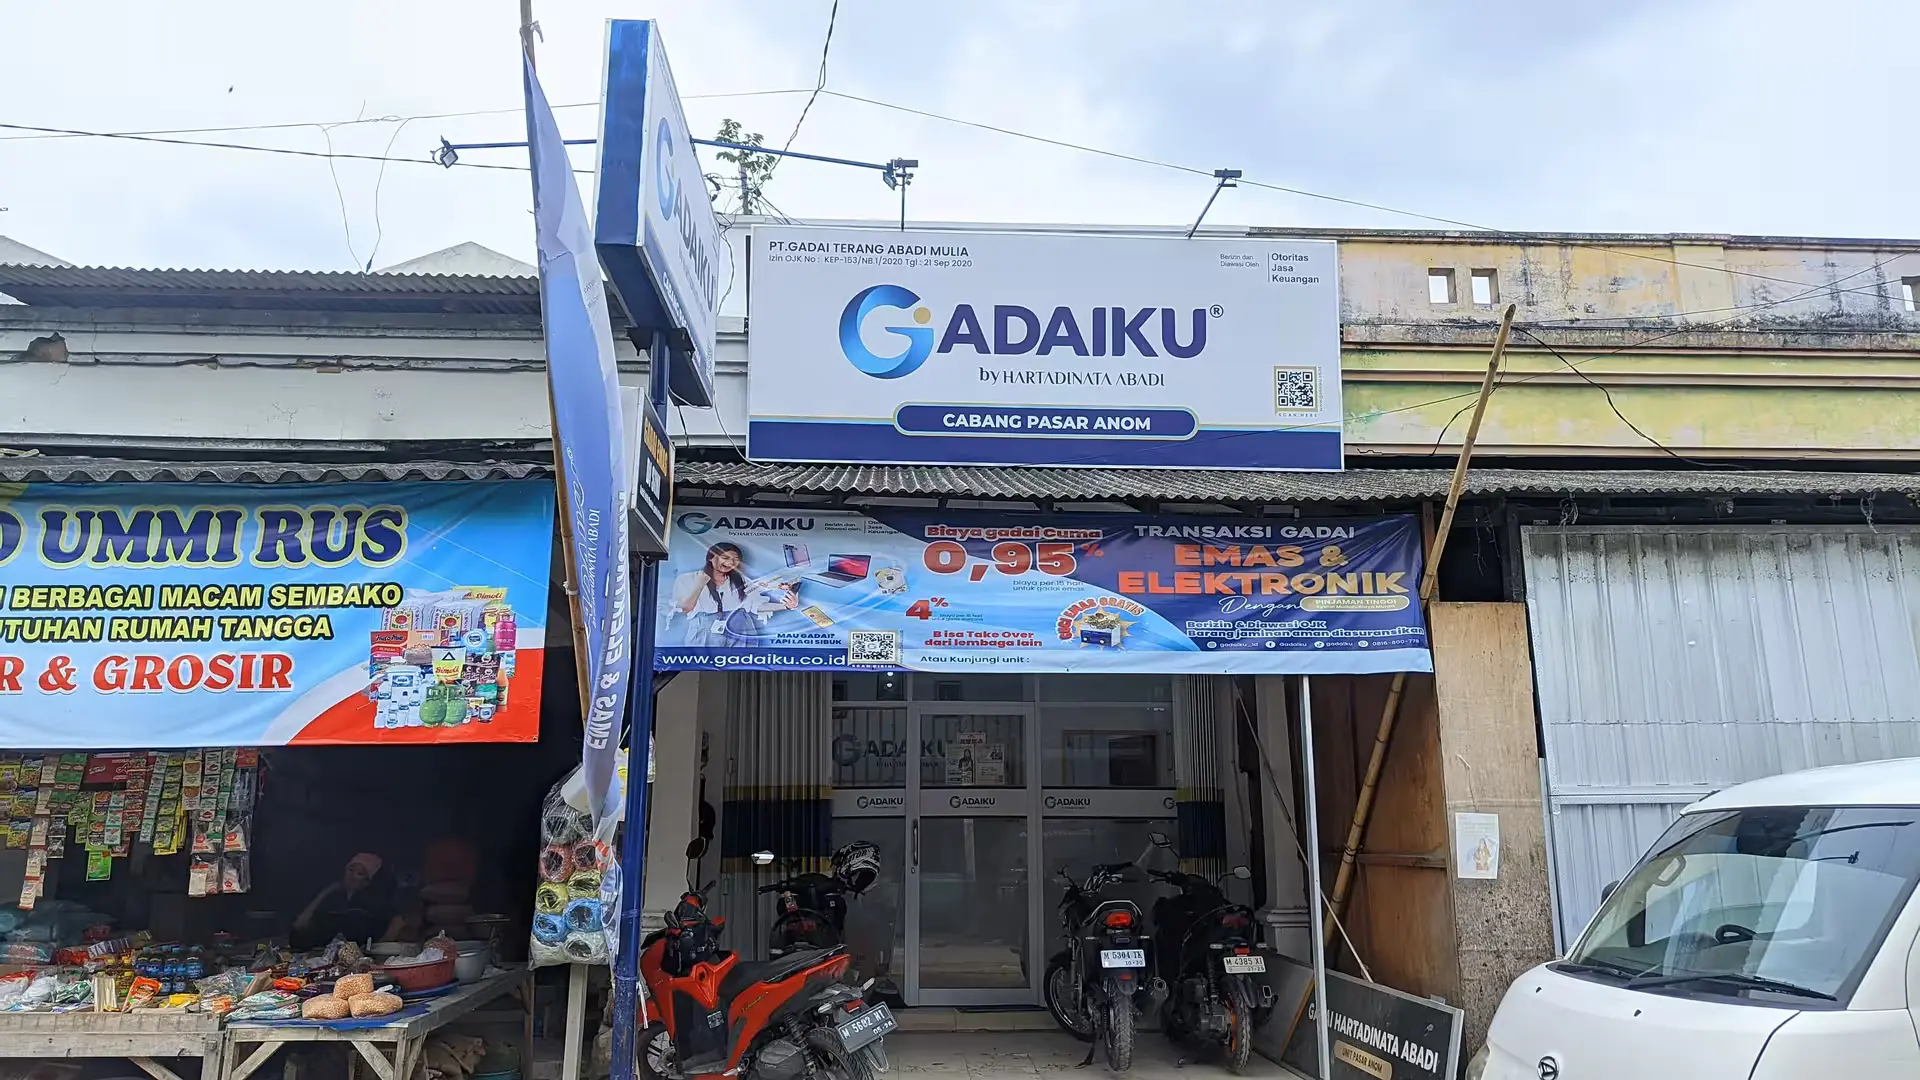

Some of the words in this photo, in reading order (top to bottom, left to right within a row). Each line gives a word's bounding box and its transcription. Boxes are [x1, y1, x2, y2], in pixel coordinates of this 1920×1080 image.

[656, 117, 715, 313] GADAIKU
[769, 241, 830, 252] PT.GADAI
[833, 243, 884, 254] TERANG
[887, 245, 927, 256] ABADI
[930, 246, 969, 257] MULIA
[905, 258, 918, 267] Tgl
[924, 259, 932, 267] 21
[934, 259, 950, 268] Sep
[952, 260, 972, 268] 2020
[1271, 252, 1309, 262] Otoritas
[1271, 264, 1294, 272] Jasa
[1272, 274, 1320, 285] Keuangan
[838, 284, 1206, 380] GADAIKU
[979, 367, 1000, 386] by
[1003, 370, 1112, 386] HARTADINATA
[1115, 371, 1165, 386] ABADI
[942, 413, 1022, 429] CABANG
[1027, 414, 1088, 430] PASAR
[1092, 415, 1151, 431] ANOM
[677, 512, 815, 535] GADAIKU
[40, 507, 243, 565] UMMI
[250, 506, 405, 565] RUS
[926, 526, 983, 539] Biaya
[985, 527, 1041, 541] gadai
[1043, 528, 1102, 539] Cuma
[1134, 525, 1272, 539] TRANSAKSI
[1280, 525, 1355, 539] GADAI
[923, 540, 1077, 582] 0,95
[1174, 544, 1303, 567] EMAS
[1319, 545, 1348, 566] &
[1118, 571, 1410, 595] ELEKTRONIK
[10, 586, 153, 609] BERBAGAI
[159, 585, 262, 608] MACAM
[270, 584, 402, 607] SEMBAKO
[906, 599, 932, 620] 4
[1218, 595, 1301, 617] Dengan
[0, 618, 103, 640] TUHAN
[111, 618, 213, 640] RUMAH
[219, 617, 332, 639] TANGGA
[1186, 620, 1232, 629] Berizin
[1299, 620, 1327, 629] OJK
[954, 639, 1015, 648] lembaga
[1017, 639, 1042, 647] lain
[662, 654, 846, 667] www.gadaiku.co.id
[950, 656, 1000, 664] Kunjungi
[38, 656, 77, 691] &
[93, 654, 293, 691] GROSIR
[435, 666, 460, 675] Bimoli
[856, 796, 904, 809] GADAIKU
[949, 795, 996, 809] GADAIKU
[1044, 796, 1091, 810] GADAIKU
[1225, 958, 1233, 966] M
[841, 1028, 851, 1039] M
[1333, 1012, 1399, 1057] HARTADINATA
[1400, 1040, 1439, 1074] ABADI
